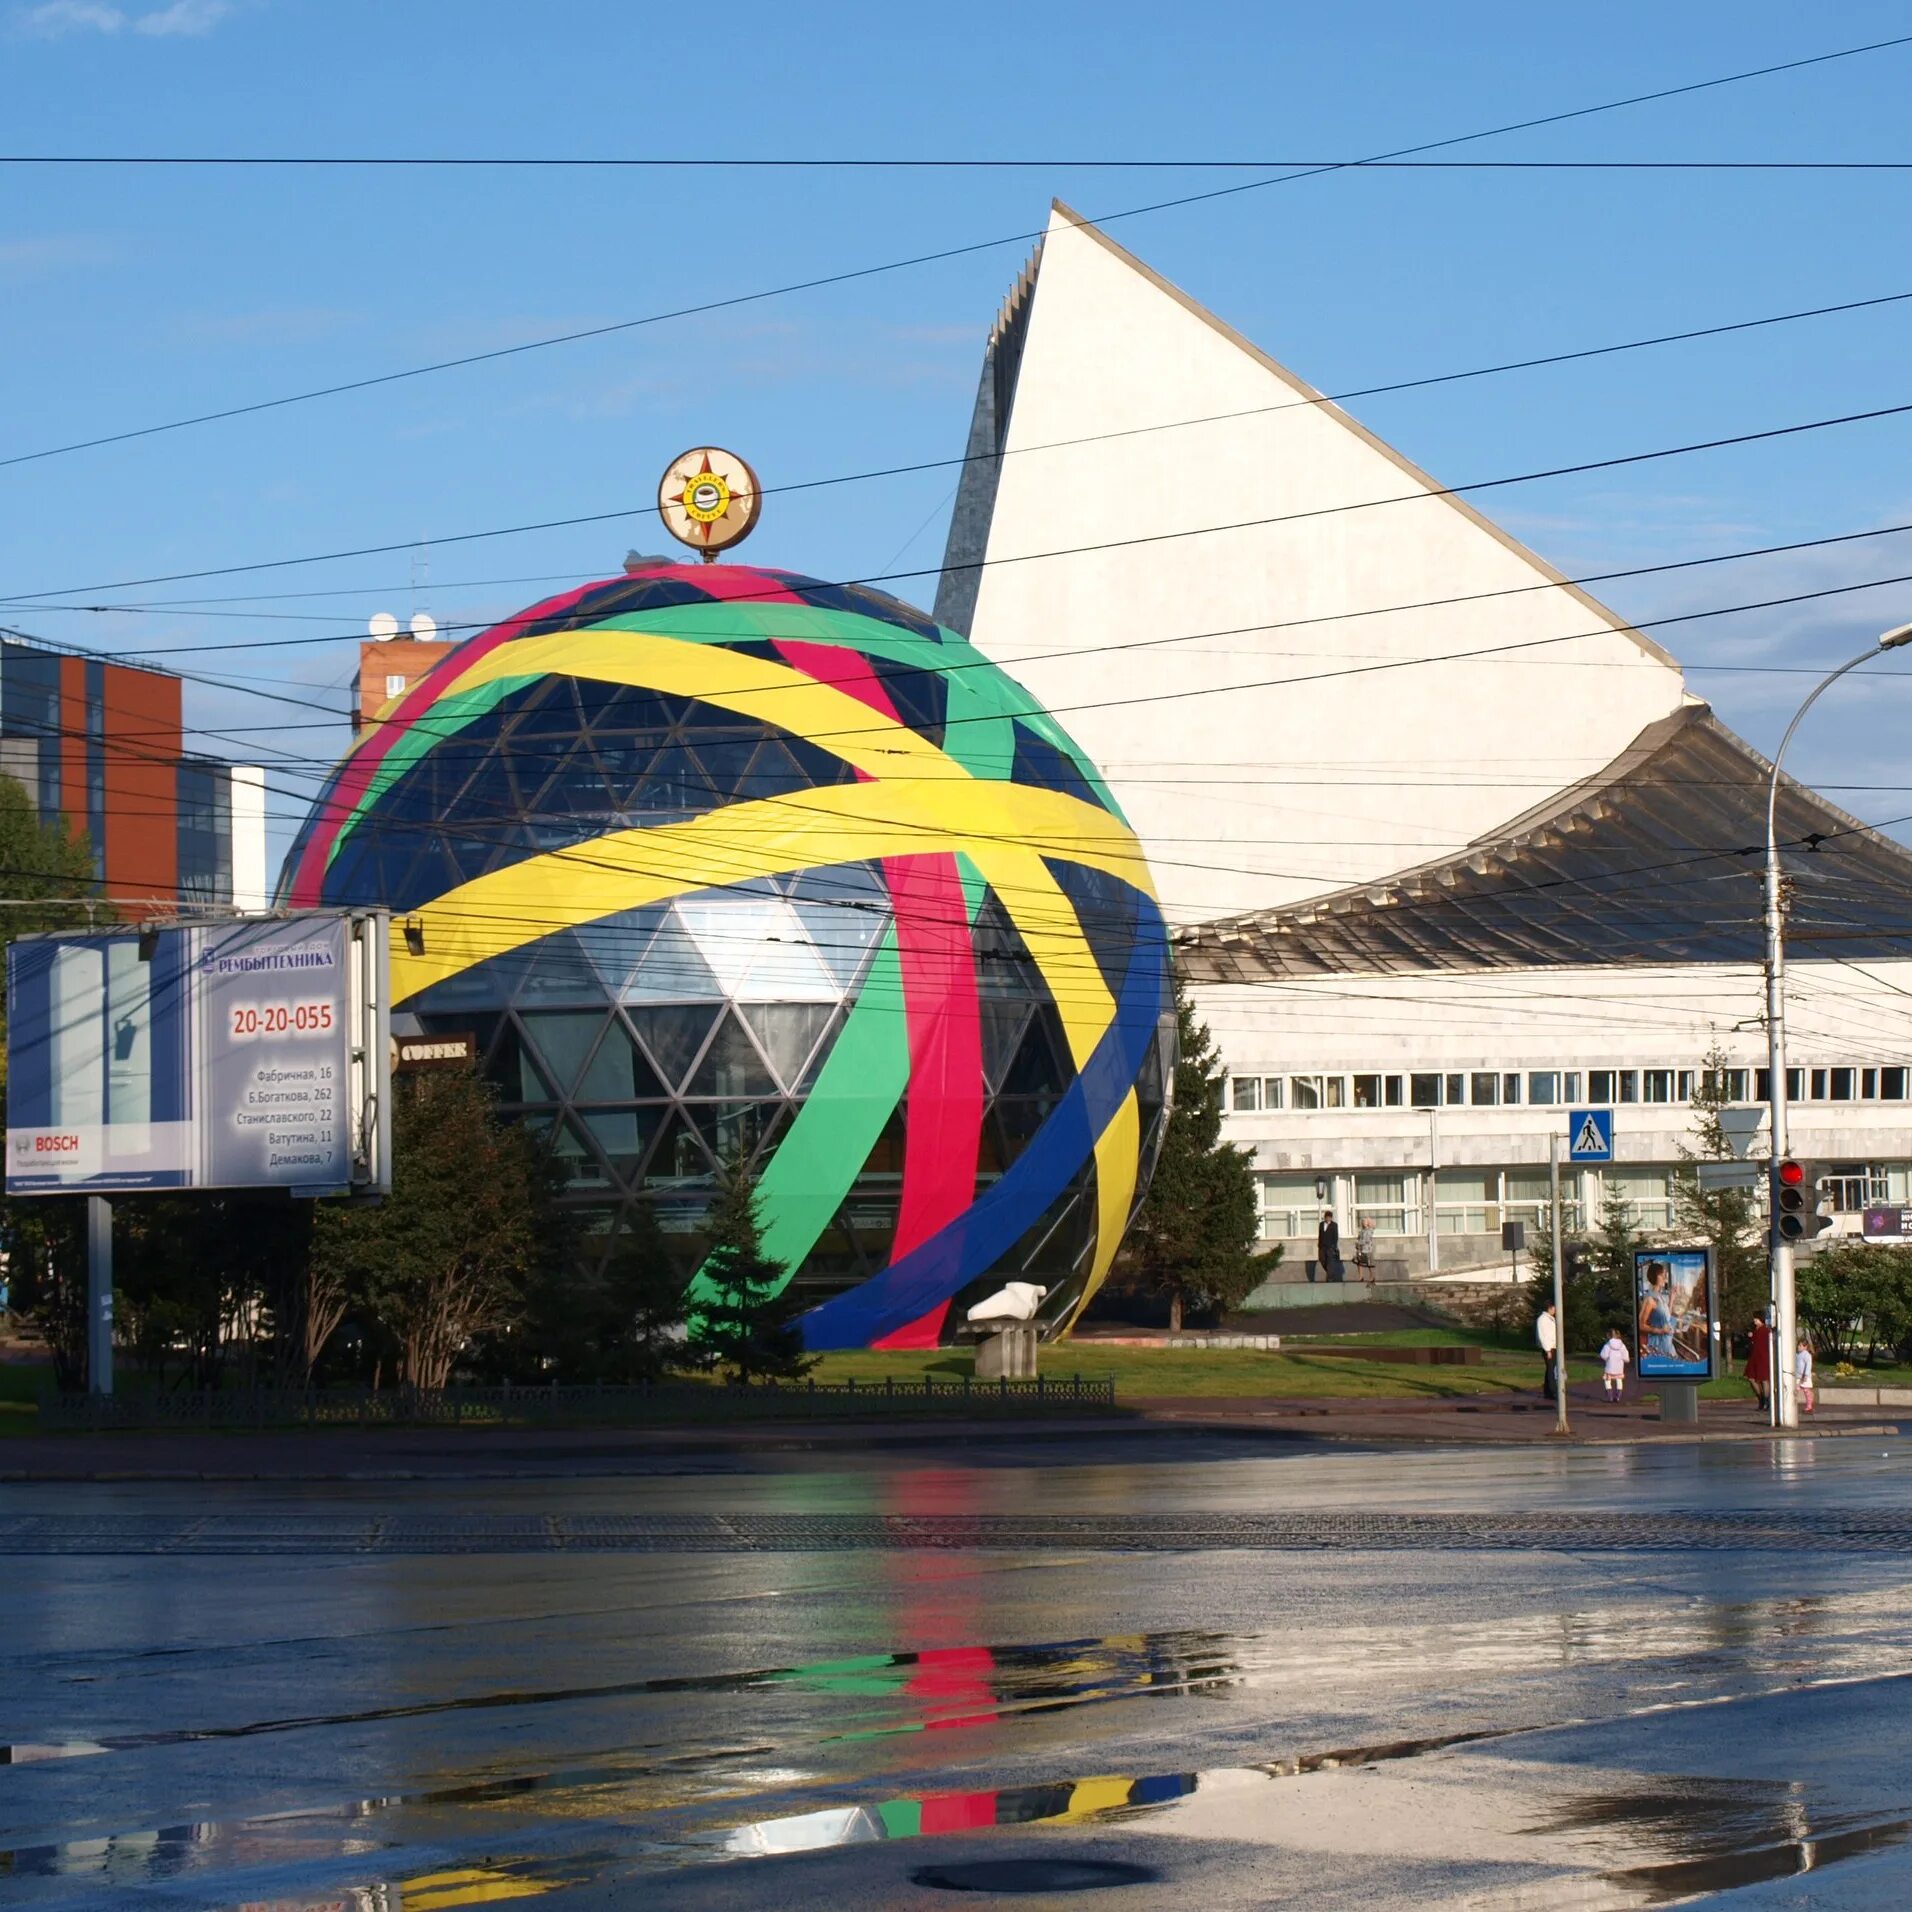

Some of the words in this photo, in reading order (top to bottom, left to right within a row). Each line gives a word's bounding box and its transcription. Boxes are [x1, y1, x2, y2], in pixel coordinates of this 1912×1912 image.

[219, 952, 333, 973] РЕМБЫТТЕХНИКА
[234, 1005, 332, 1033] 20-20-055
[257, 1069, 317, 1083] Фабричная,
[320, 1067, 332, 1079] 16
[249, 1090, 312, 1103] Б.Богаткова,
[314, 1088, 332, 1100] 262
[237, 1112, 317, 1125] Станиславского,
[320, 1109, 332, 1121] 22
[36, 1136, 79, 1151] BOSCH
[269, 1132, 318, 1146] Ватутина,
[321, 1130, 332, 1142] 11
[269, 1153, 323, 1167] Демакова,
[326, 1151, 332, 1163] 7
